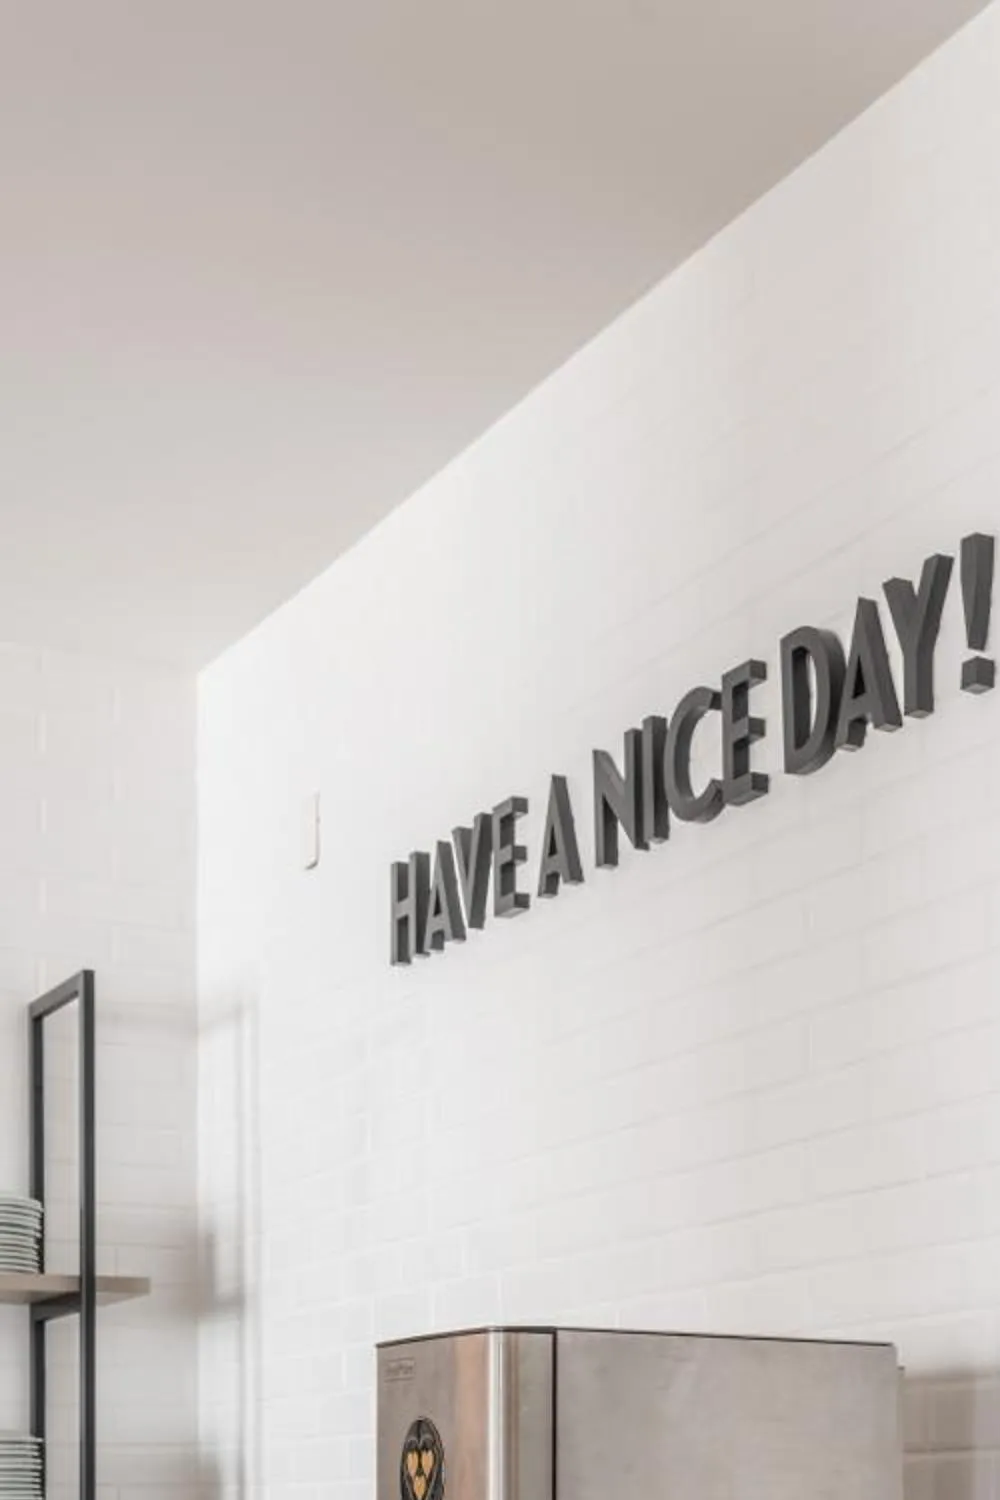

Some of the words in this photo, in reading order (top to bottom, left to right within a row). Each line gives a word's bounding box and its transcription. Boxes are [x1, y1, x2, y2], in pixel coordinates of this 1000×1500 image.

[390, 796, 530, 966] HAVE
[537, 774, 585, 899] A
[592, 659, 770, 870] NICE
[779, 532, 996, 776] DAY!
